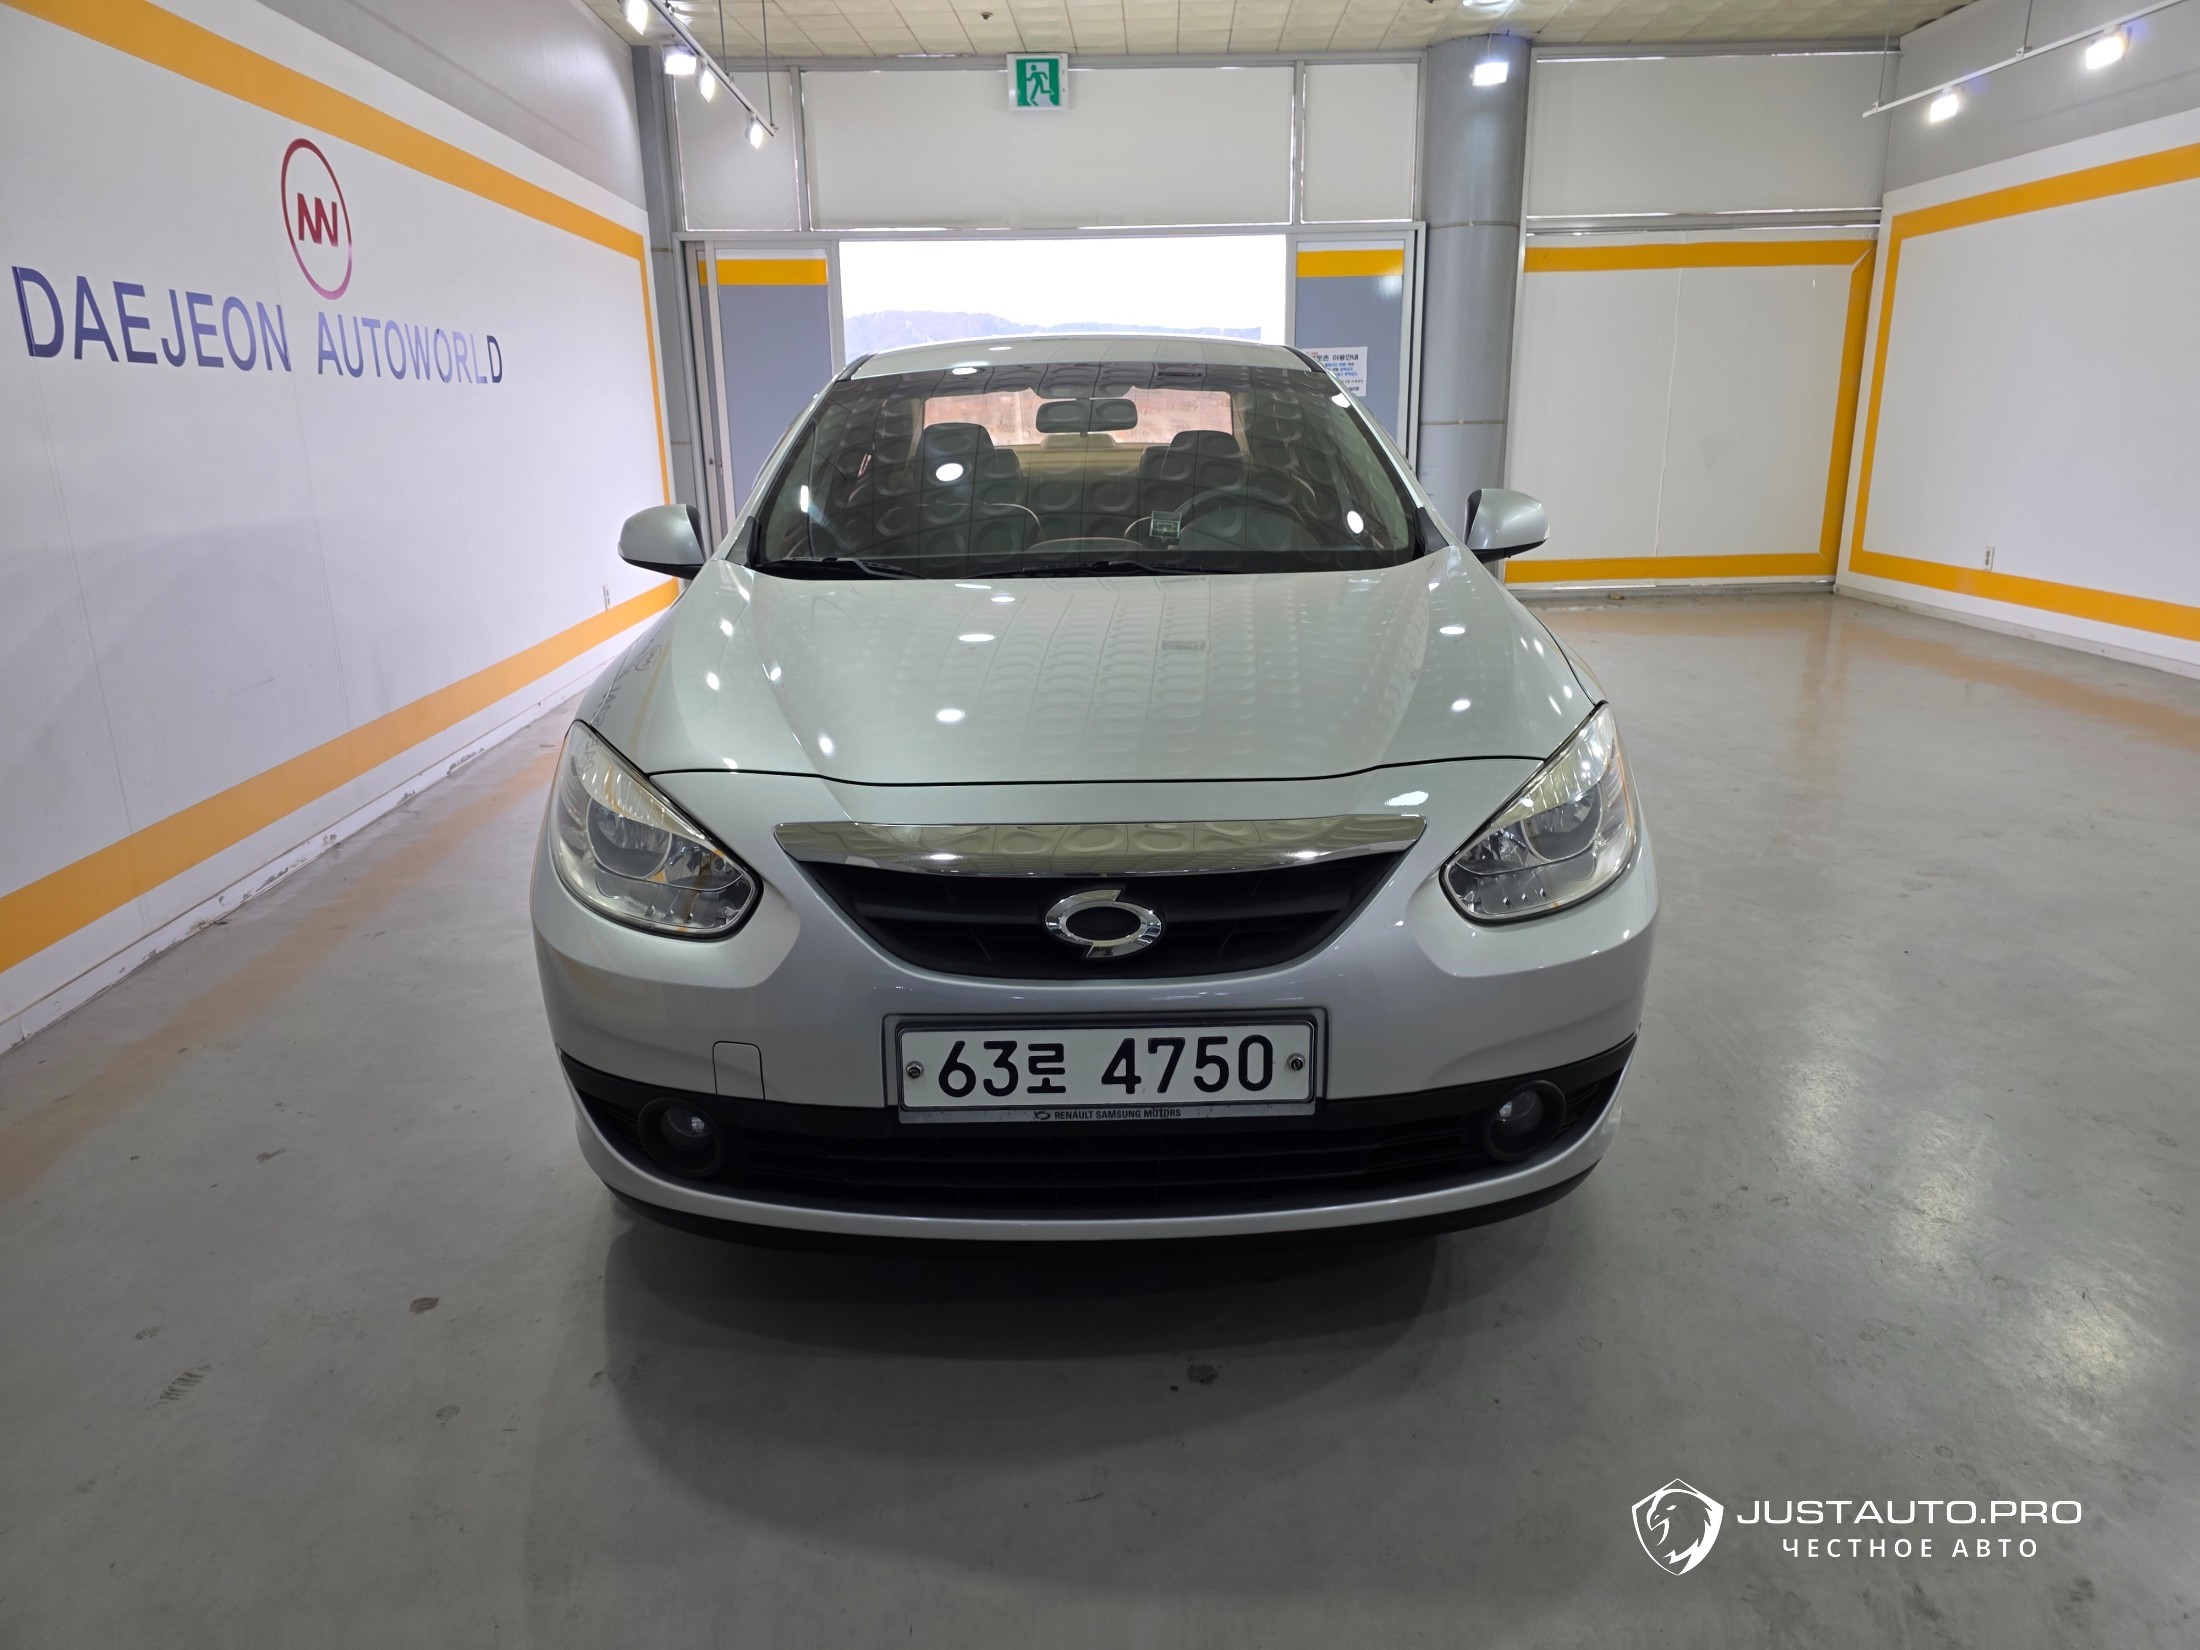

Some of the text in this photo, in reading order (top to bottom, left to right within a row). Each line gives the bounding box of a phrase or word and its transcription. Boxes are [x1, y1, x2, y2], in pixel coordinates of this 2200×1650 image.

[11, 265, 503, 384] DAEJEON AUTOWORLD
[938, 1034, 1274, 1098] 63로 4750
[1054, 1108, 1181, 1120] RENAULT SAMSUNG MOTORS
